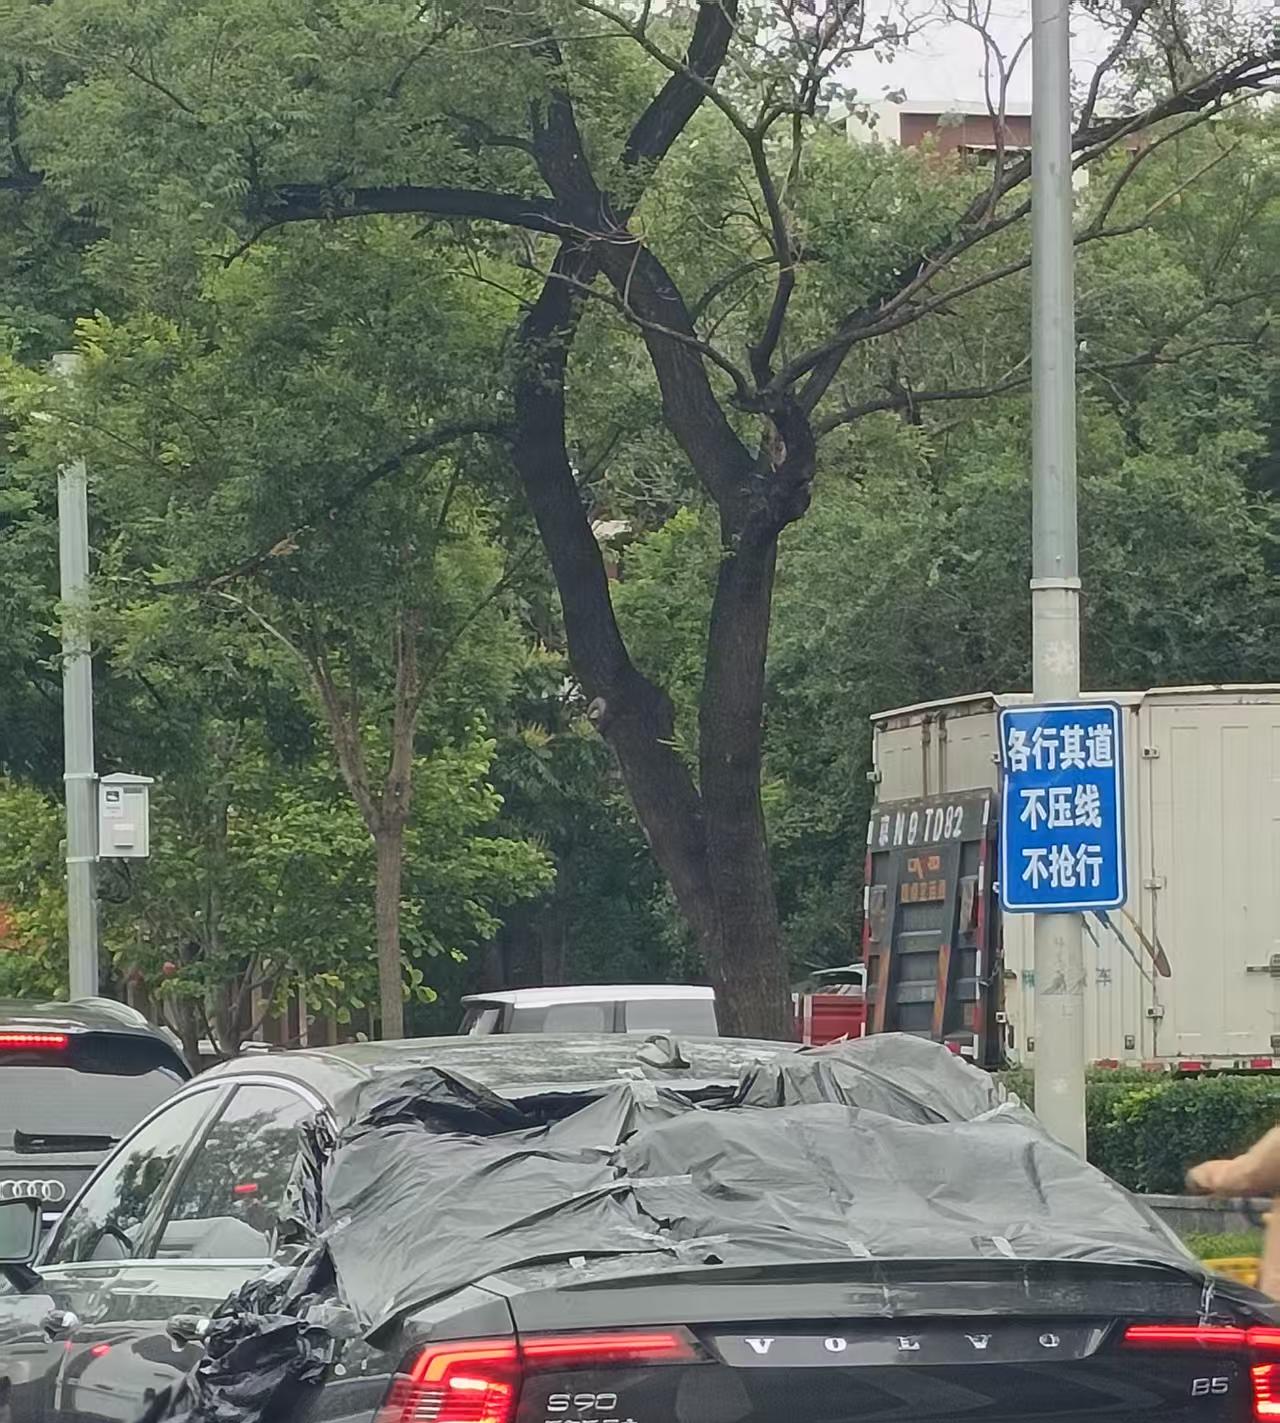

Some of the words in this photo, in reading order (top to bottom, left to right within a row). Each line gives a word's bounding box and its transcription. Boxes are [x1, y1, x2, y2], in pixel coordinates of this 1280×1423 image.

[1008, 723, 1114, 773] 各行其道
[1020, 783, 1103, 832] 不压线
[1021, 843, 1104, 890] 不抢行
[745, 1332, 1061, 1355] VOLVO
[546, 1392, 618, 1412] S90
[1191, 1376, 1229, 1396] B5
